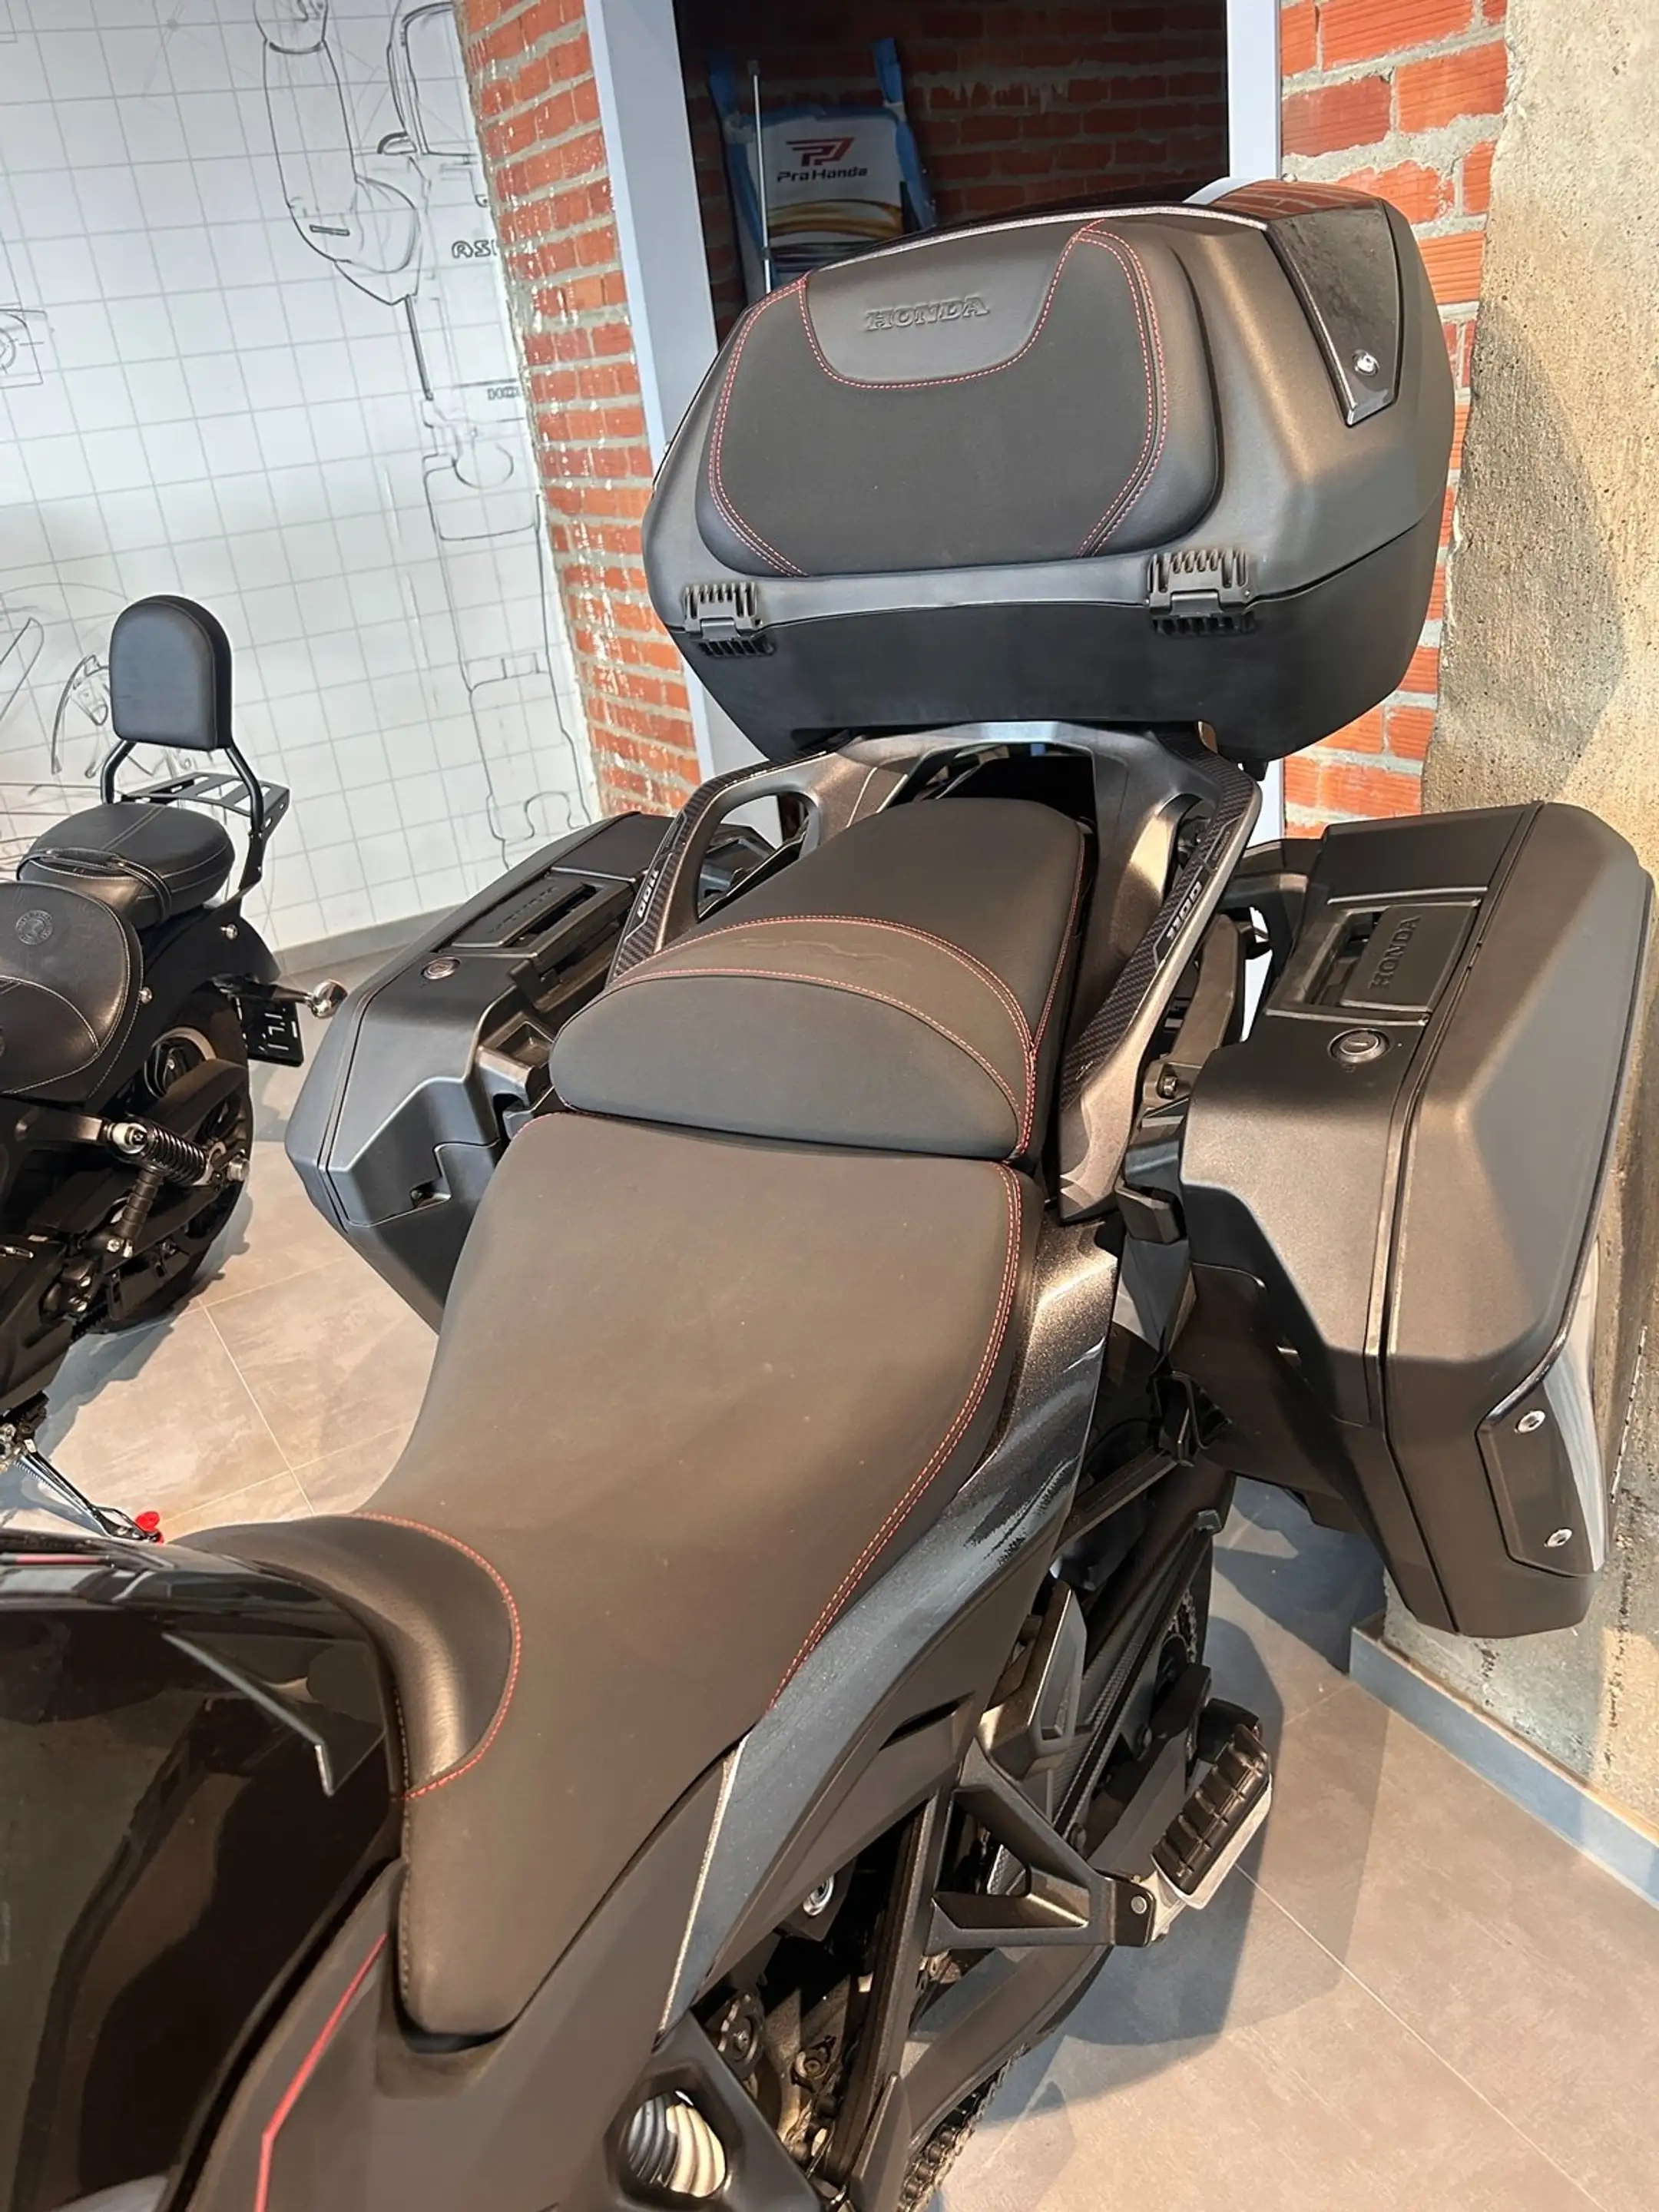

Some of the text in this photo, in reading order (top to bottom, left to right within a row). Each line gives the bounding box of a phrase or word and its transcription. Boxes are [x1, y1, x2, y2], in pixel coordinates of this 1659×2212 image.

[865, 295, 991, 332] HONDA
[1158, 880, 1203, 940] 1100
[1367, 915, 1422, 990] HONDA
